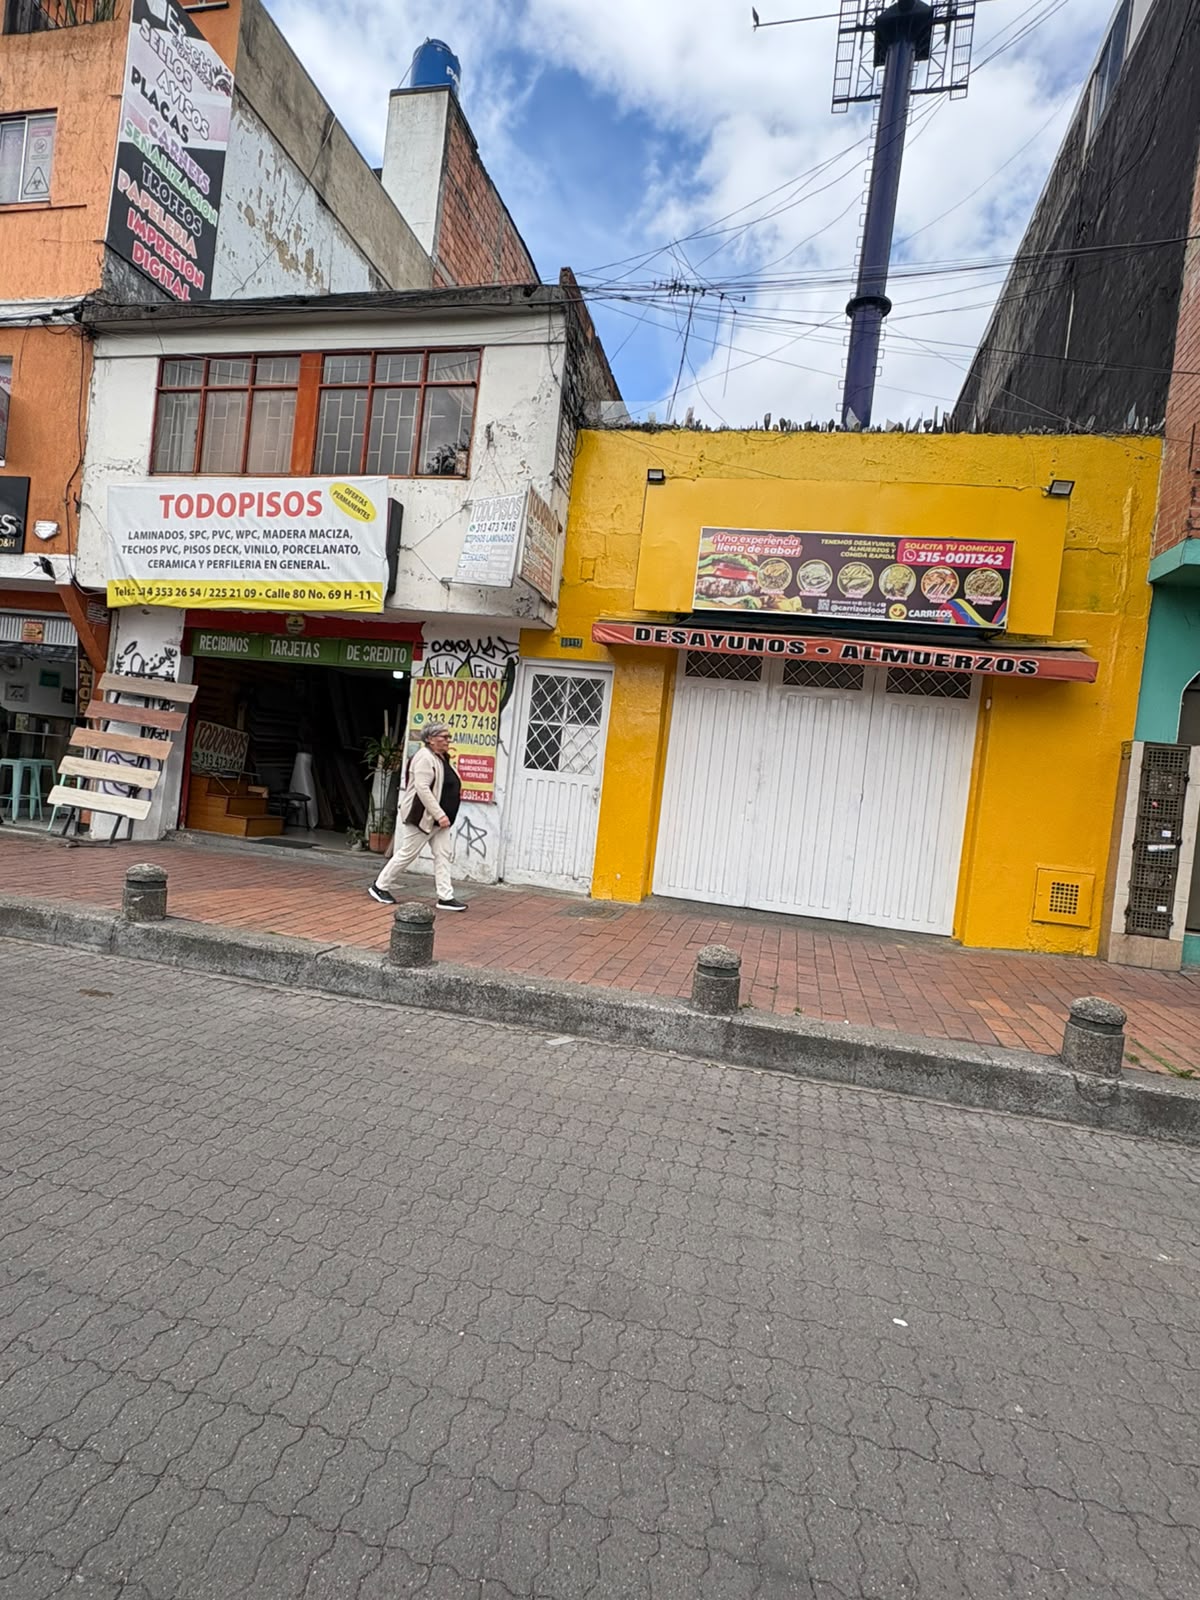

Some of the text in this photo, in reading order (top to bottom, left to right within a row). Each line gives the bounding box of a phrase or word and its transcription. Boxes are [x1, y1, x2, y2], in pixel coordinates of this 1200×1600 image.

[139, 18, 193, 93] SELLOS
[131, 66, 188, 143] PLACAS
[156, 69, 209, 141] AVISOS
[148, 117, 210, 195] CARNETS
[142, 162, 202, 237] TROFEOS
[117, 168, 197, 259] PAPELERIA
[127, 207, 205, 291] IMPRESION
[132, 240, 191, 301] DIGITAL
[159, 490, 322, 519] TODOPISOS
[344, 487, 368, 507] OFERTAS
[128, 528, 353, 541] LAMINADOS, SPC, PVC, WPC, MADERA MACIZA,
[476, 521, 517, 533] 313 473 7418
[122, 544, 361, 556] TECHOS PVC, PISOS DECK, VINILO, PORCELANATO,
[717, 543, 800, 555] llena de sabor!
[740, 536, 799, 546] experiencia
[905, 543, 943, 551] SOLICITA
[958, 545, 1006, 553] DOMICILIO
[147, 559, 330, 570] CERAMICA Y PERFILERIA EN GENERAL.
[840, 551, 868, 559] COMIDA
[917, 551, 1004, 566] 315-0011342
[155, 587, 173, 597] 353
[175, 587, 187, 597] 26
[189, 587, 202, 597] 54
[209, 588, 227, 598] 225
[229, 588, 243, 598] 21
[243, 588, 257, 599] 09
[264, 588, 291, 599] Calle
[292, 588, 306, 599] 80
[308, 589, 326, 600] No.
[328, 589, 341, 600] 69
[343, 589, 352, 600] H
[199, 634, 250, 654] RECIBIMOS
[269, 639, 321, 659] TARJETAS
[346, 645, 361, 661] DE
[635, 627, 1039, 676] DESAYUNOS ALMUERZOS
[416, 679, 499, 714] TODOPISOS
[448, 713, 468, 729] 473
[471, 715, 497, 731] 7418
